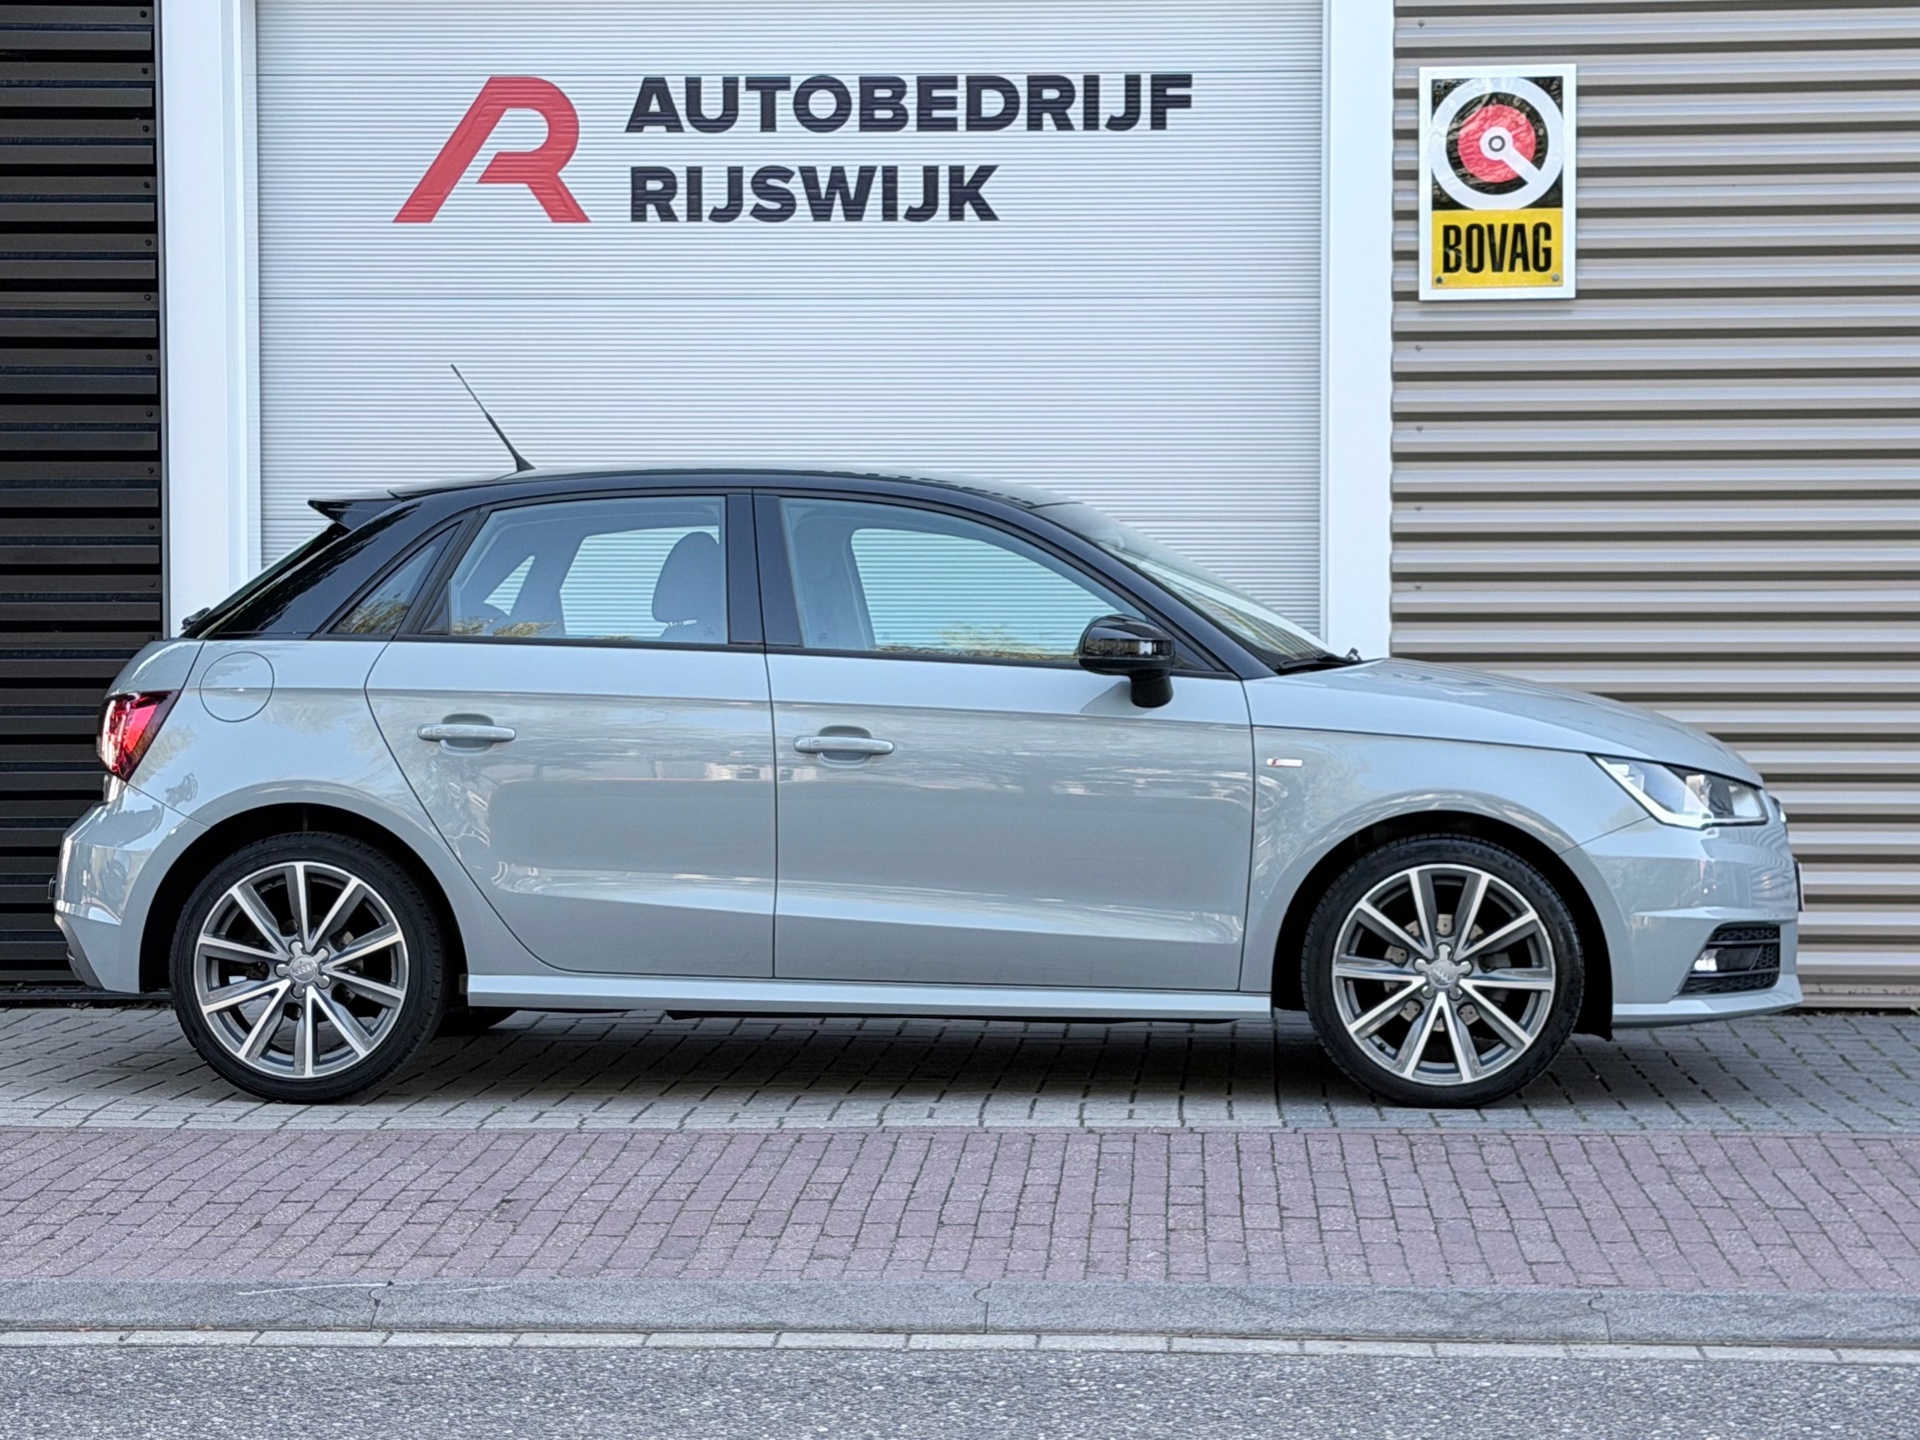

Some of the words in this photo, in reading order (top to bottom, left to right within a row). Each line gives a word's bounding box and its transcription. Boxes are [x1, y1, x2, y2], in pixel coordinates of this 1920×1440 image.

[625, 74, 1193, 133] AUTOBEDRIJF
[631, 165, 999, 222] RIJSWIJK
[1442, 222, 1552, 274] BOVAG
